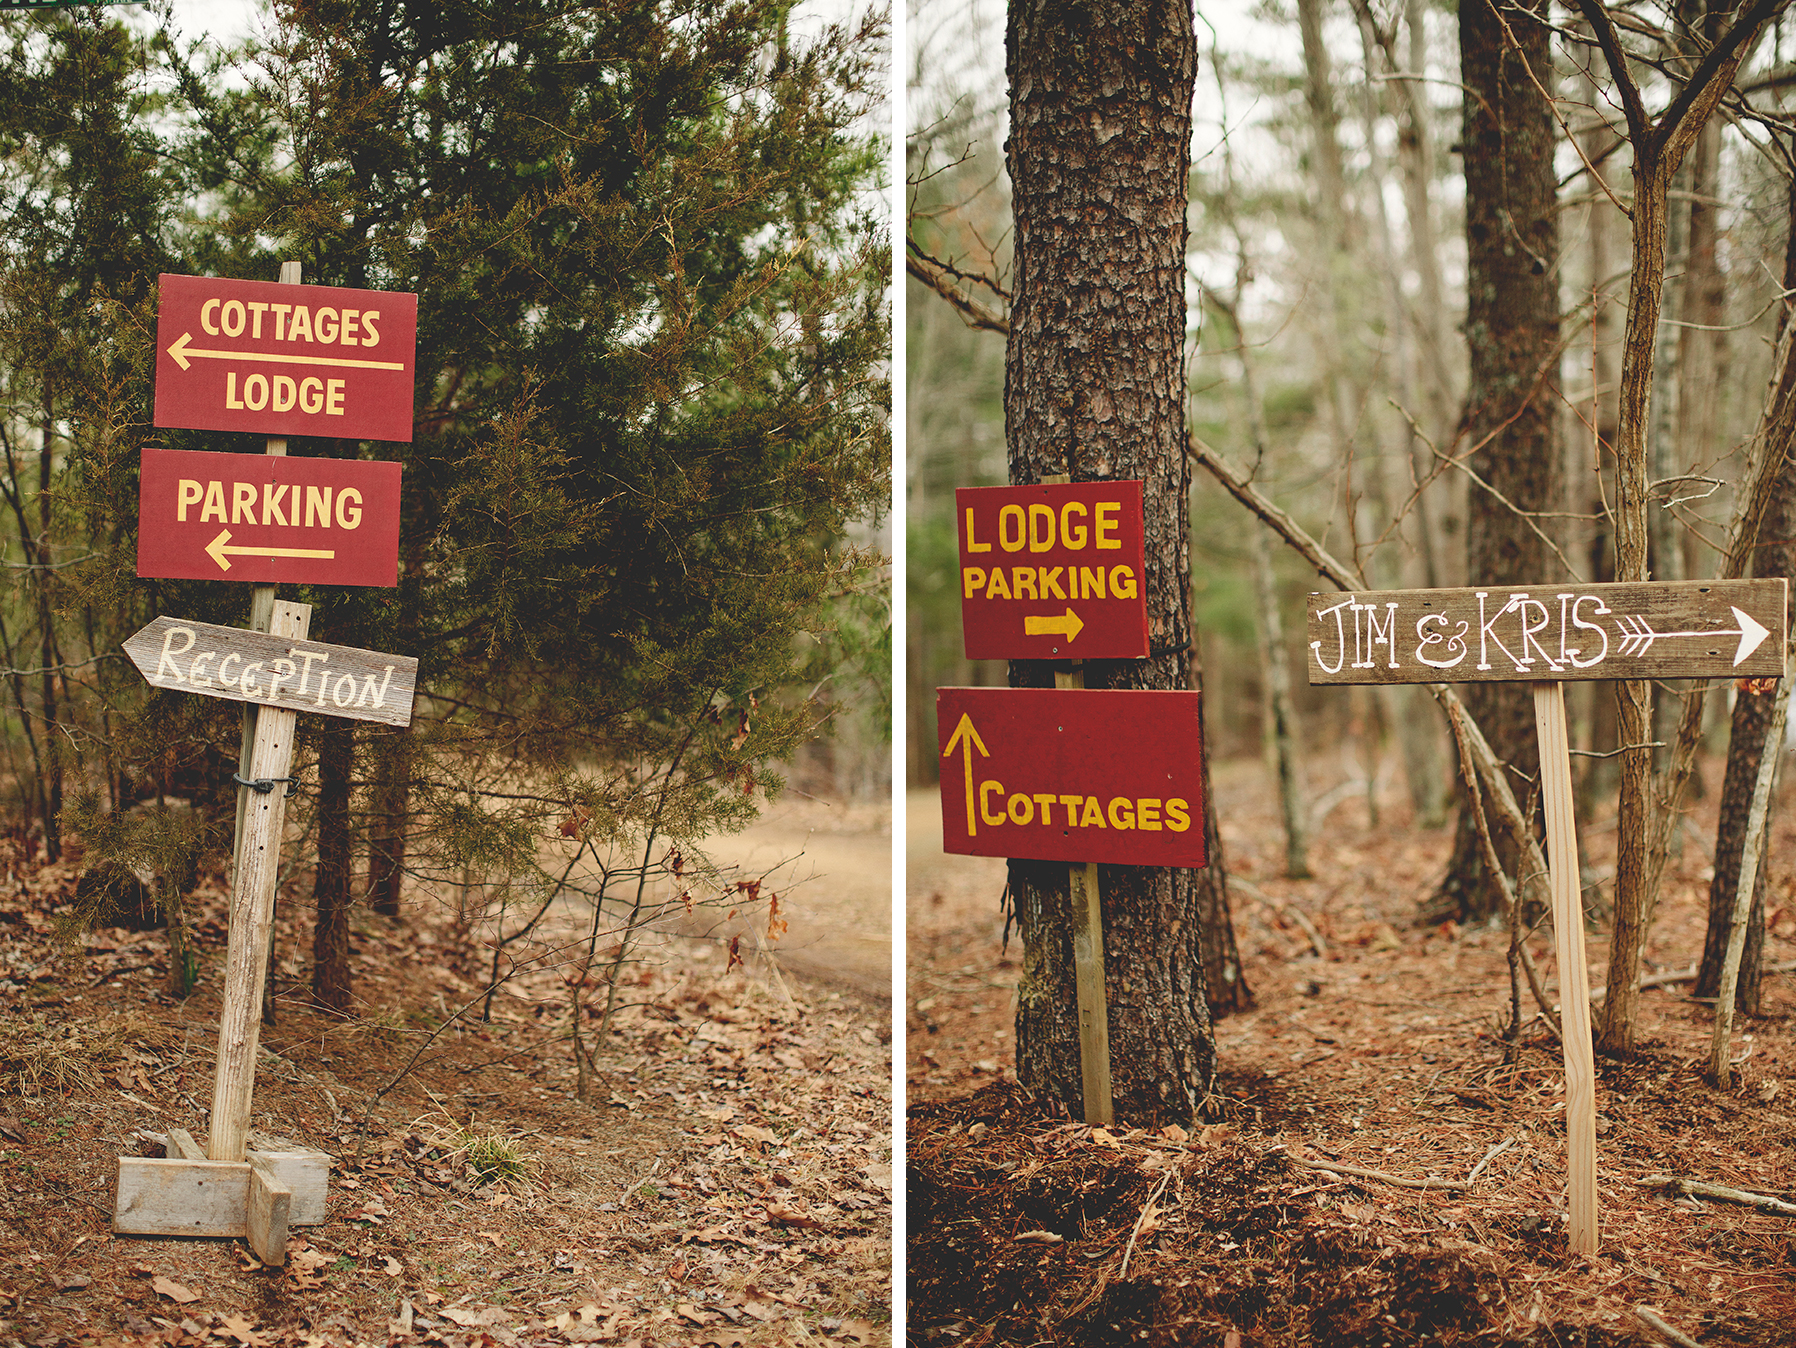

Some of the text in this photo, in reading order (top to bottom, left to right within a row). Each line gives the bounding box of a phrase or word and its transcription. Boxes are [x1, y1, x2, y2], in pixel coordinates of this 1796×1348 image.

[200, 298, 381, 348] COTTAGES
[225, 372, 346, 416] LODGE
[177, 479, 363, 530] PARKING
[965, 501, 1122, 553] LODGE
[963, 564, 1138, 600] PARKING
[1310, 592, 1612, 674] JIM & KRIS
[153, 627, 395, 709] RECEPTION
[979, 780, 1192, 832] COTTAGES
